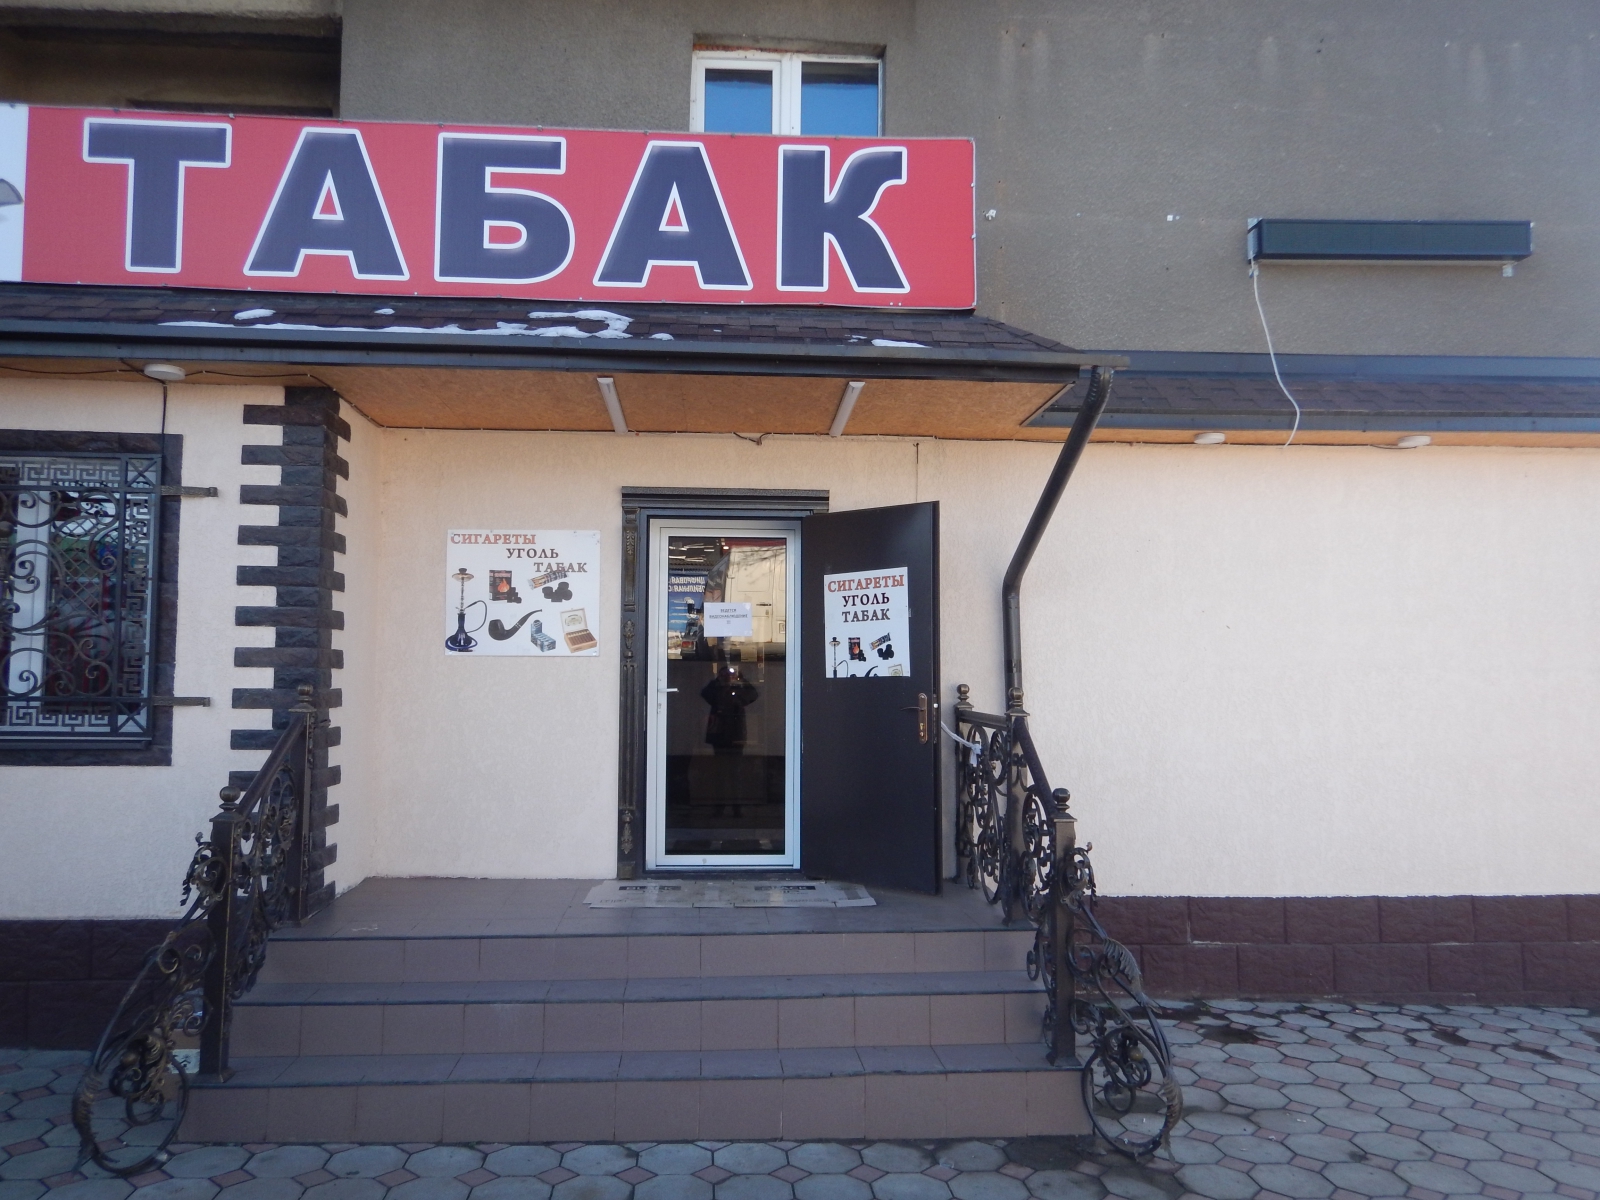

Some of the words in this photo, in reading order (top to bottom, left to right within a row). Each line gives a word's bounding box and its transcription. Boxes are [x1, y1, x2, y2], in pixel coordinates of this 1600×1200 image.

[82, 117, 911, 294] ТАБАК
[450, 533, 537, 545] СИГАРЕТЫ
[506, 548, 559, 559] УГОЛЬ
[534, 562, 588, 573] ТАБАК
[828, 575, 904, 592] СИГАРЕТЫ
[842, 592, 890, 607] УГОЛЬ
[842, 608, 890, 623] ТАБАК
